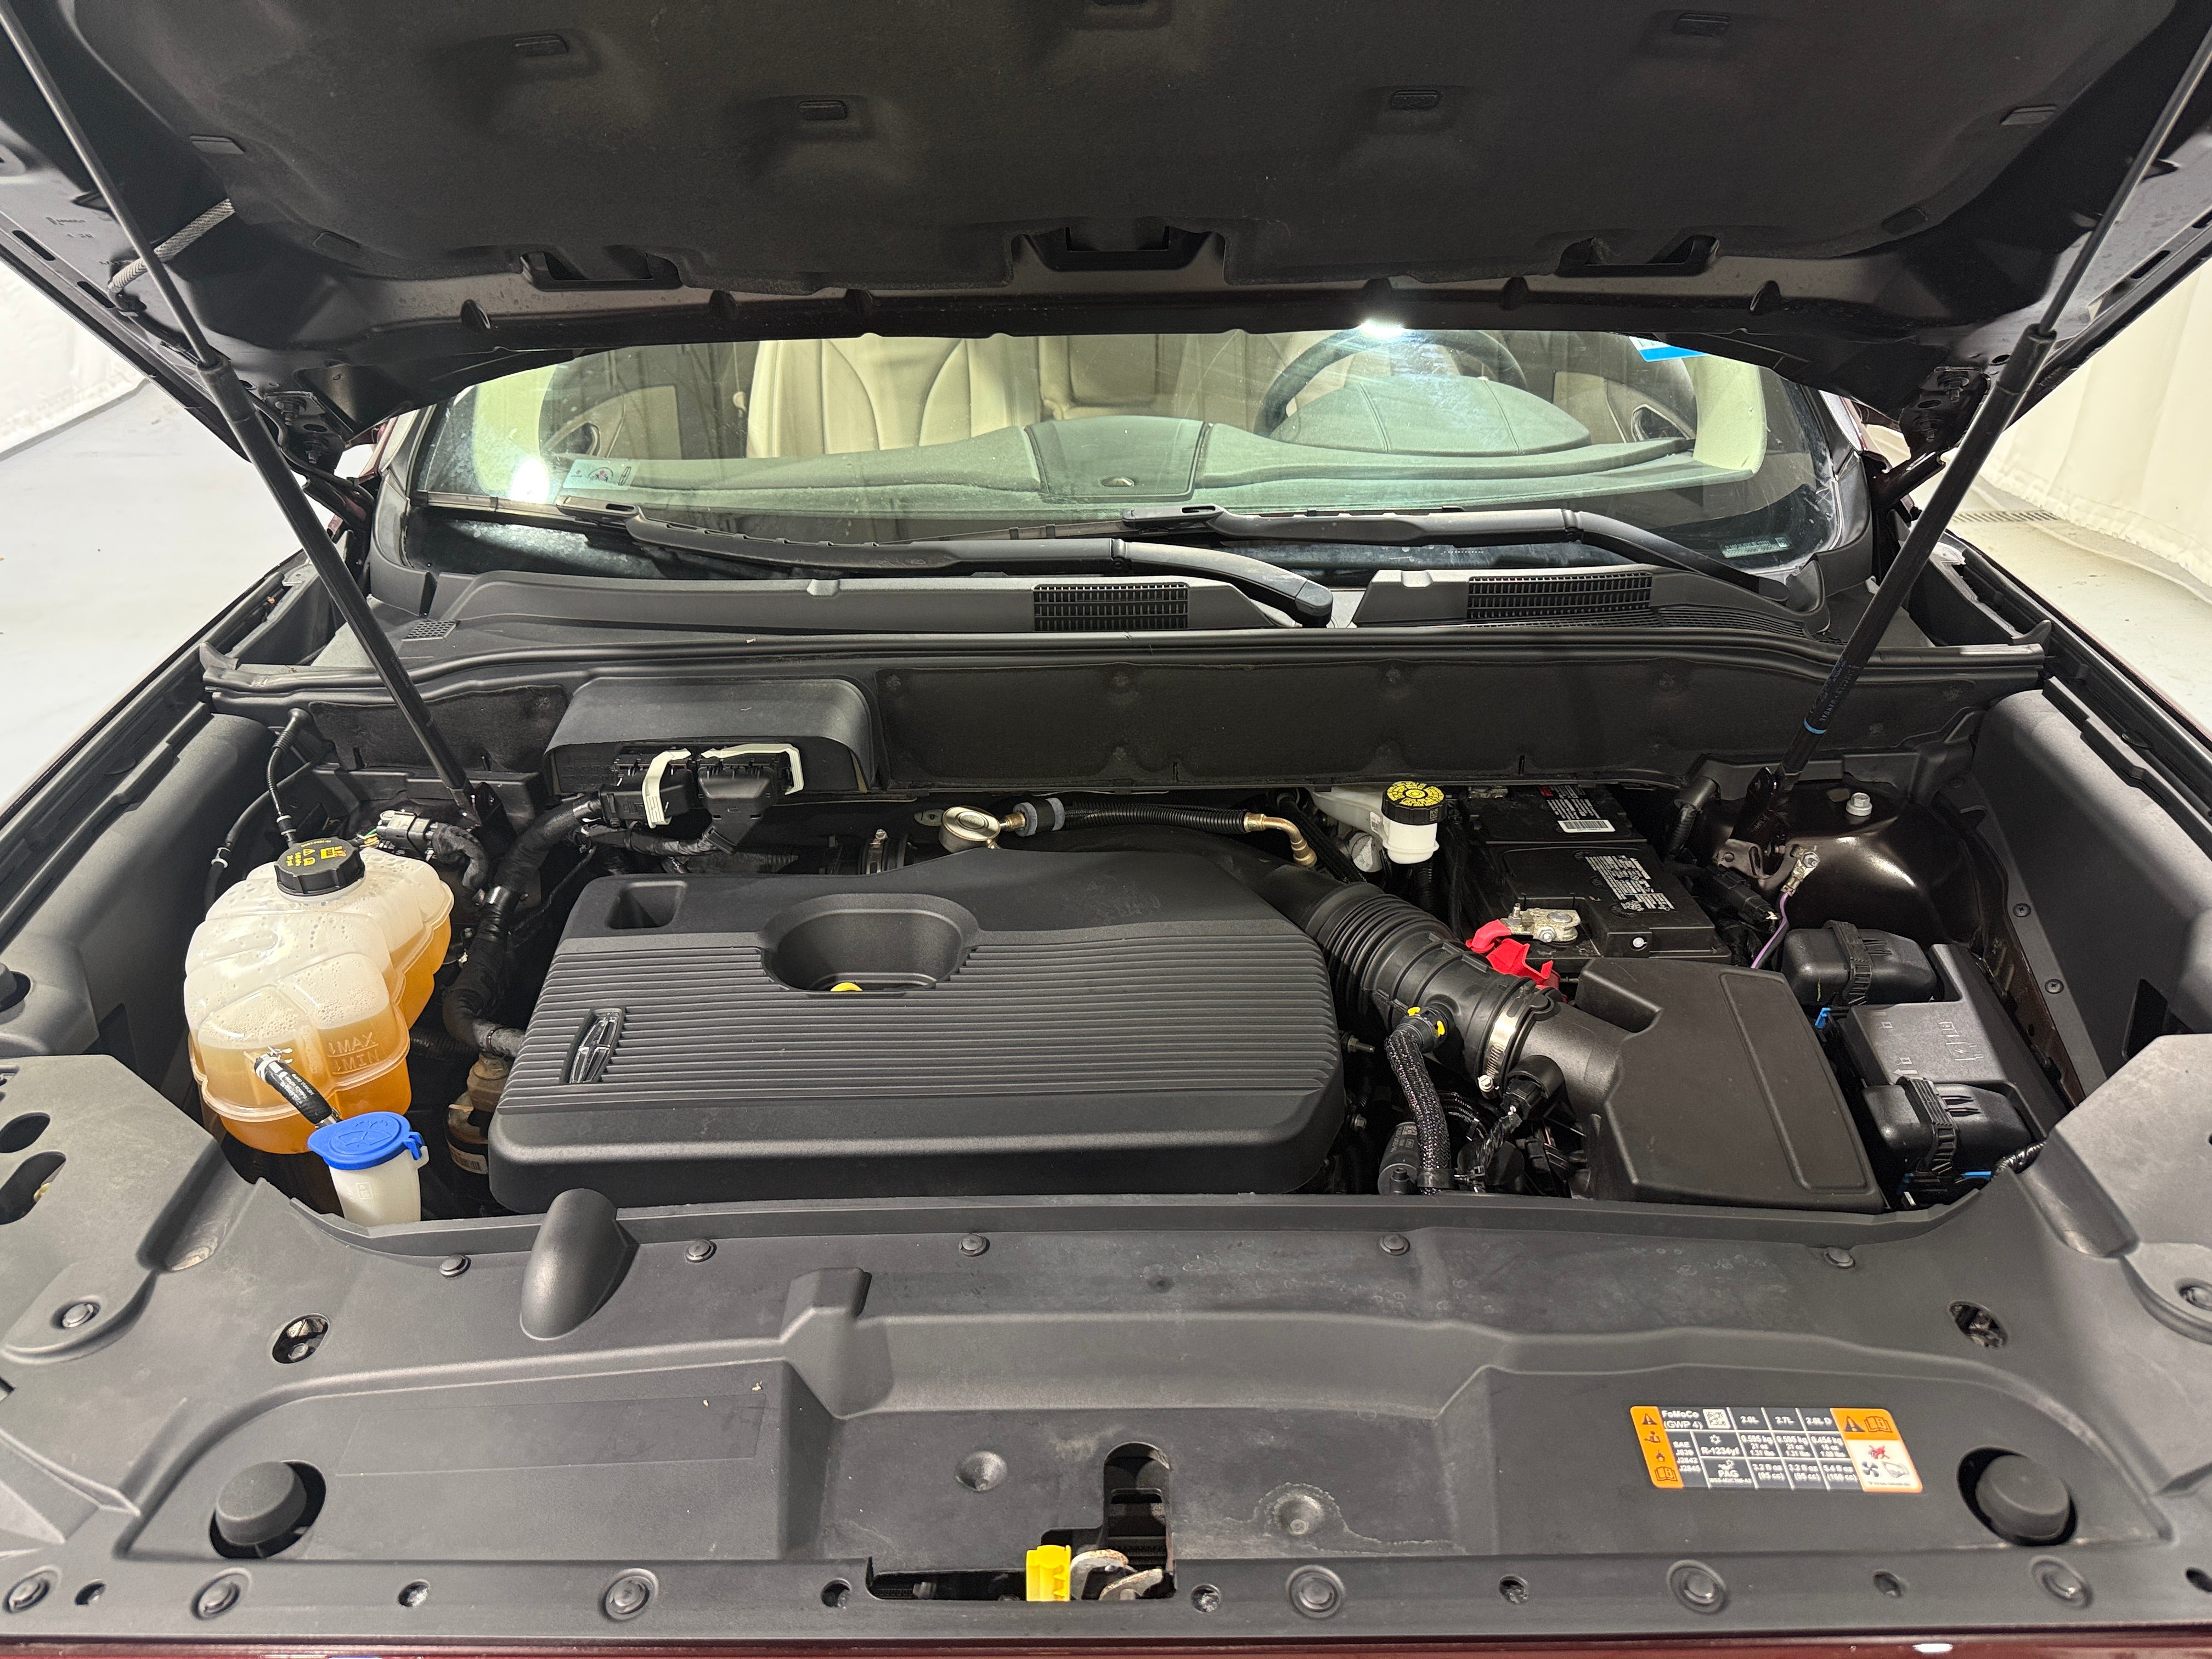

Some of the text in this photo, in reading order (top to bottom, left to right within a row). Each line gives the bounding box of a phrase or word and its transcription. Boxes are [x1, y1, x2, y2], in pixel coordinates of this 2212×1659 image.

[337, 1031, 375, 1053] MAX
[342, 1048, 380, 1070] MIN
[1661, 1410, 1700, 1418] FoMoCo
[1663, 1420, 1703, 1429] (GWP 4)
[1775, 1416, 1795, 1424] 2.7L
[1762, 1435, 1773, 1445] kg
[1797, 1436, 1809, 1445] kg
[1831, 1436, 1843, 1446] kg
[1701, 1447, 1740, 1456] R-1234yf
[1758, 1472, 1785, 1481] (95 cc)
